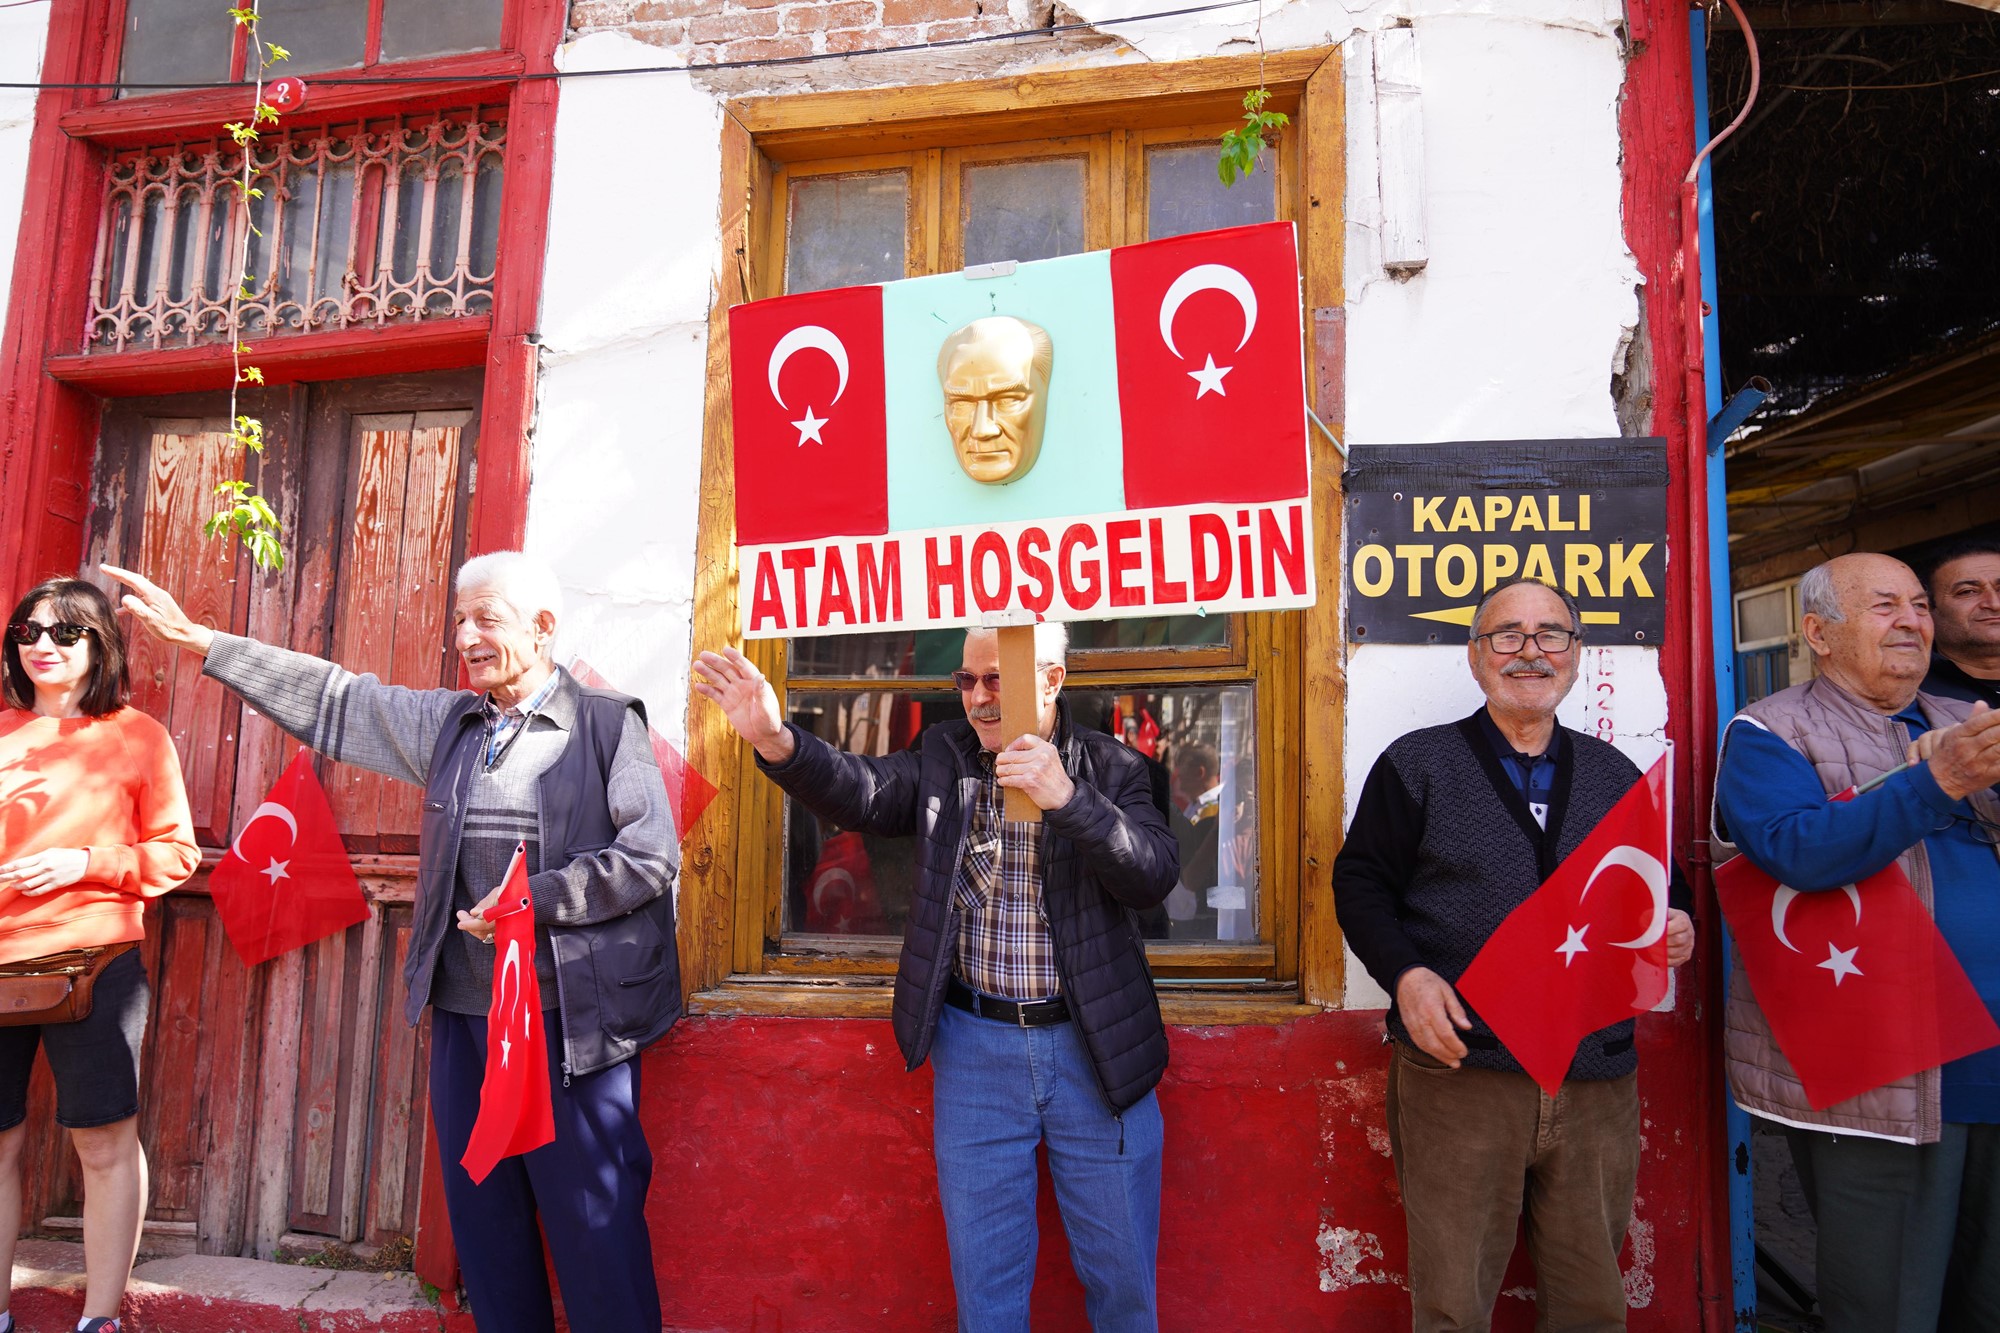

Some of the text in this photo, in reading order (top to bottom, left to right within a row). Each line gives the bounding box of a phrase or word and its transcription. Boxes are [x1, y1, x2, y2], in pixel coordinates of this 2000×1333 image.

[277, 82, 291, 103] 2
[1412, 494, 1591, 532] KAPALI
[749, 540, 902, 632] ATAM
[1352, 543, 1655, 598] OTOPARK
